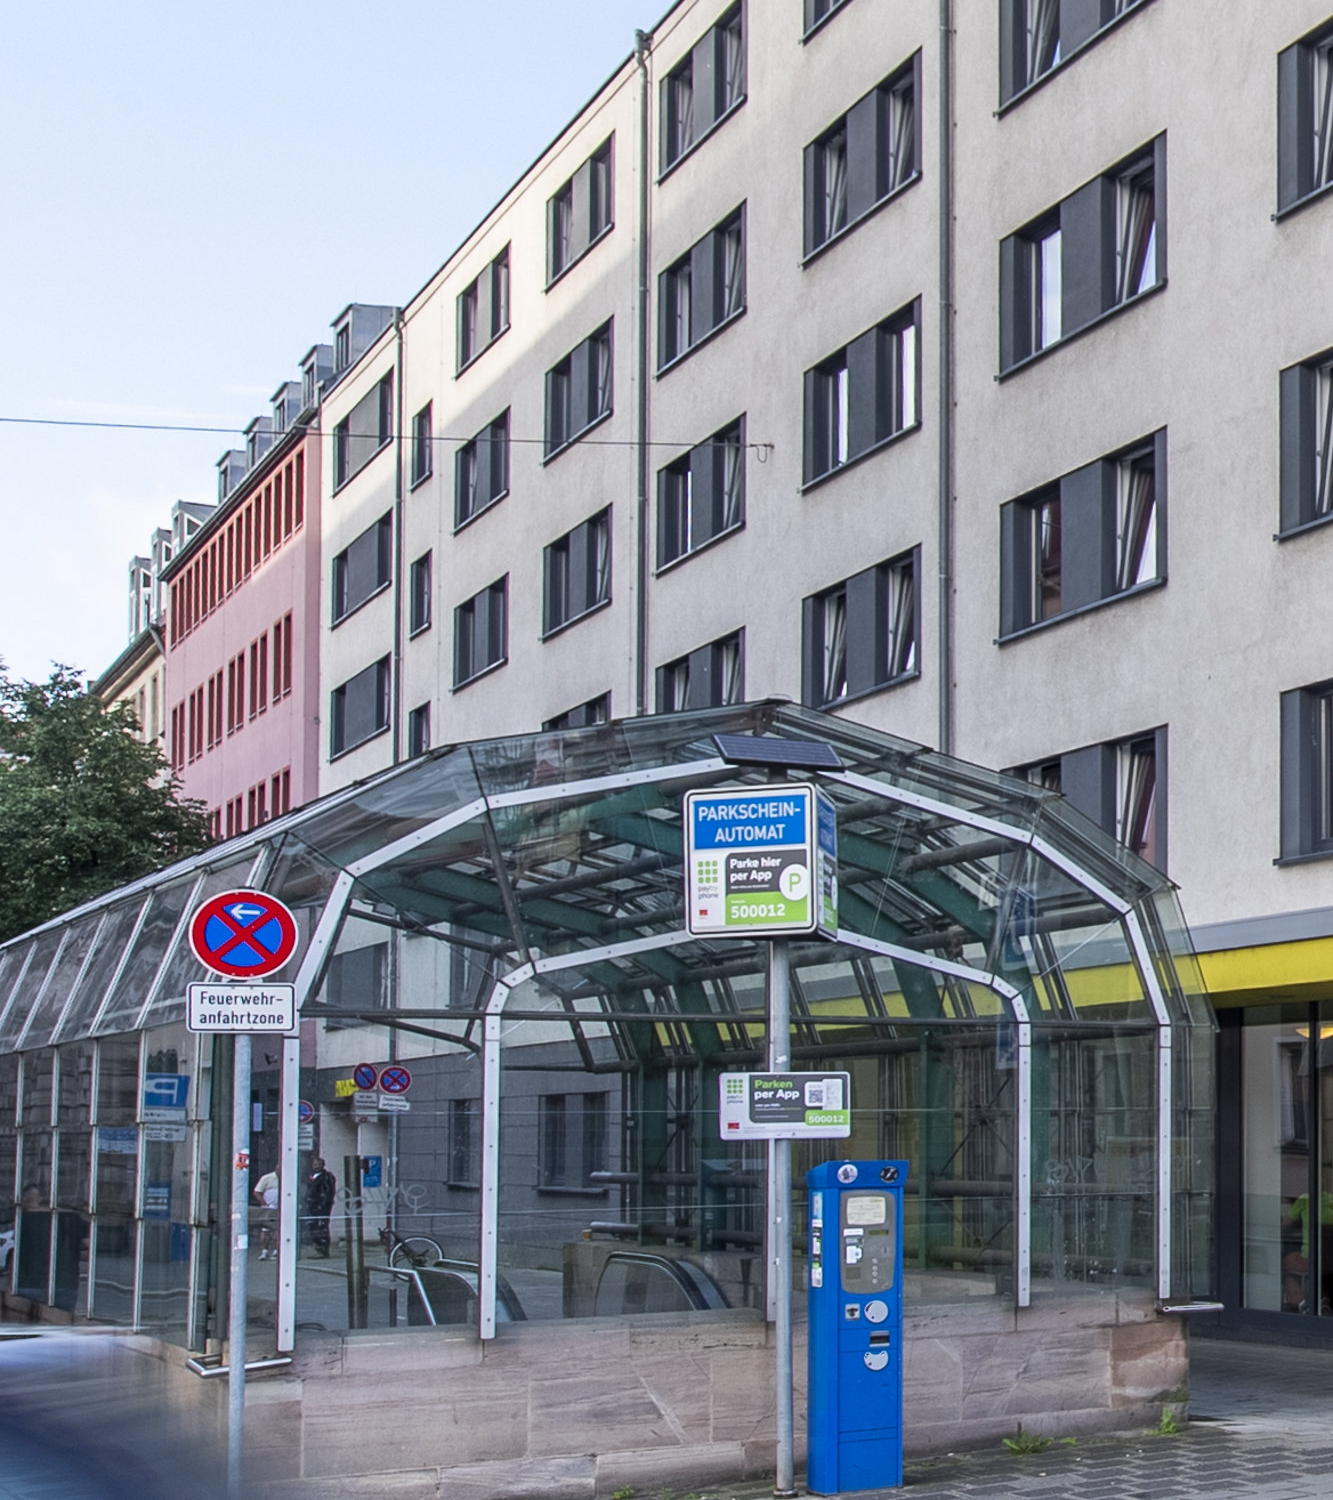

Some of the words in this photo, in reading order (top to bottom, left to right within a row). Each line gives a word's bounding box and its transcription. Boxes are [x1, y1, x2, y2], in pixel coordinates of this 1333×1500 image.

[698, 802, 801, 822] PARKSCHEIN-
[714, 824, 786, 843] AUTOMAT
[729, 858, 759, 869] Parke
[761, 856, 782, 867] hier
[729, 873, 748, 883] per
[750, 869, 772, 882] App
[731, 904, 786, 918] 500012
[200, 991, 284, 1005] Feuerwehr-
[199, 1011, 284, 1024] anfahrtzone
[755, 1080, 793, 1089] Parken
[754, 1090, 773, 1100] per
[776, 1089, 799, 1099] App
[808, 1115, 844, 1124] 500012
